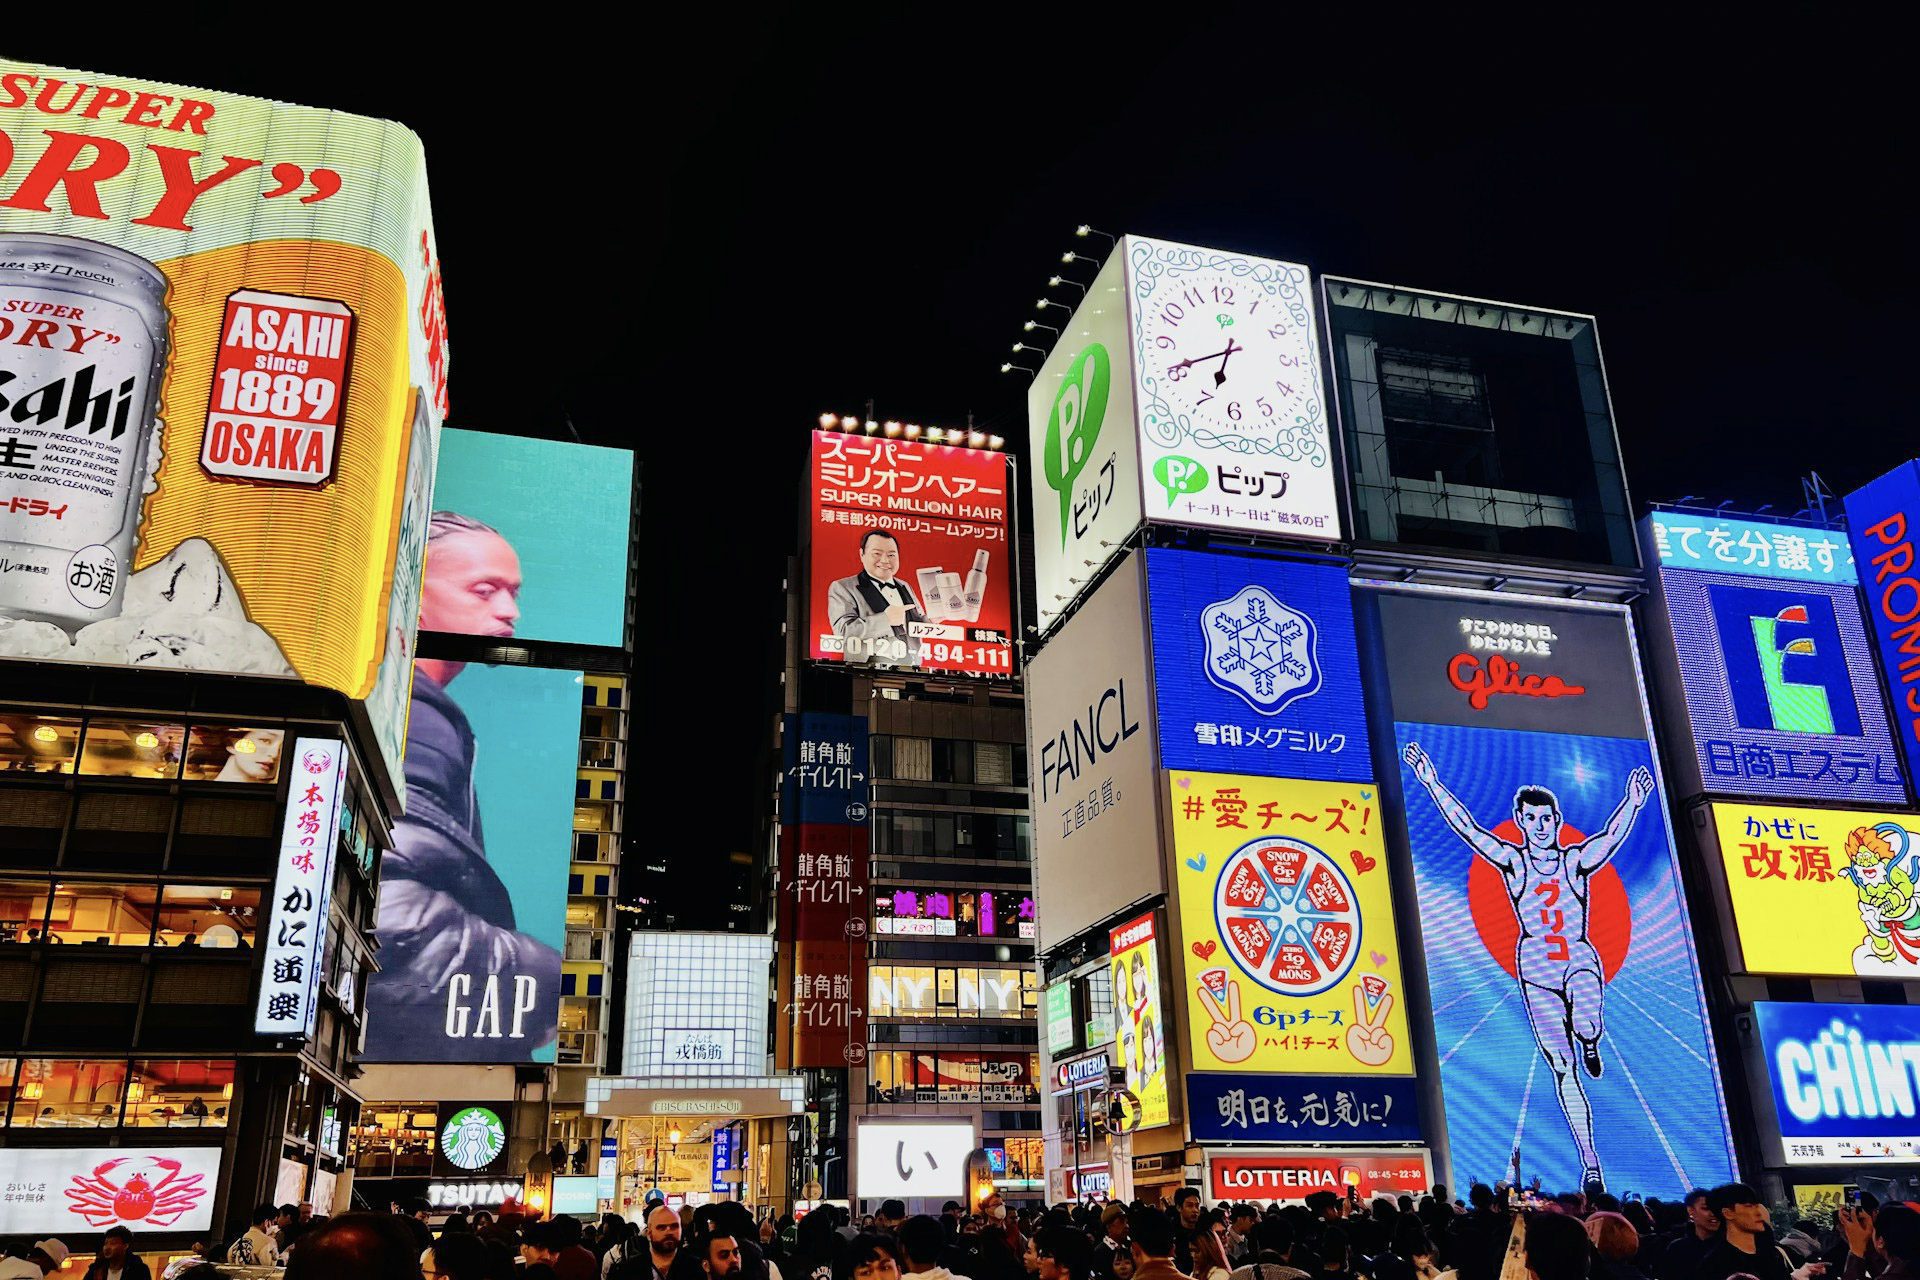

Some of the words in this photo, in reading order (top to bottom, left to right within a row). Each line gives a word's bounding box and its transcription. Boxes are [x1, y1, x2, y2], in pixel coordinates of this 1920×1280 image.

[1, 73, 216, 135] SUPER
[74, 269, 115, 284] KUCHI
[1183, 287, 1205, 308] 11
[1211, 285, 1235, 306] 12
[1249, 300, 1260, 315] 1
[3, 299, 84, 321] SUPER
[1160, 302, 1185, 327] 10
[225, 306, 345, 360] ASAHI
[1155, 335, 1176, 350] 9
[1268, 323, 1287, 340] 2
[254, 353, 309, 375] since
[1167, 365, 1188, 382] 8
[1279, 354, 1299, 368] 3
[219, 367, 336, 421] 1889
[1196, 389, 1215, 406] 7
[1276, 380, 1295, 397] 4
[1226, 401, 1242, 421] 6
[1256, 396, 1273, 418] 5
[22, 427, 48, 438] WITH
[50, 432, 93, 446] PRECISION
[94, 441, 105, 450] TO
[105, 443, 121, 455] HIGH
[45, 443, 77, 454] UNDER
[79, 449, 95, 459] THE
[209, 420, 324, 474] OSAKA
[820, 437, 922, 467] スーパー
[43, 453, 81, 467] MASTER
[5, 471, 29, 480] AND
[62, 479, 90, 492] CLEAN
[40, 465, 59, 474] ING
[62, 468, 116, 487] TECHNIQUES
[820, 460, 1002, 499] ミリオンヘアー
[1217, 464, 1290, 499] ピップ
[820, 488, 883, 508] SUPER
[887, 496, 954, 517] MILLION
[958, 504, 1003, 521] HAIR
[1073, 451, 1117, 540] ピップ
[70, 560, 116, 597] お酒
[912, 624, 946, 637] ルアン
[1470, 635, 1552, 656] ゆたかな人生
[1447, 652, 1586, 710] Glico
[1041, 677, 1140, 804] FANCL
[1193, 722, 1346, 755] 雪印メグミルク
[800, 740, 854, 765] 龍角散
[1704, 739, 1904, 785] 日商エステム
[1061, 776, 1122, 839] 正直品質。
[291, 782, 324, 875] 本場の味
[1743, 815, 1819, 841] かぜに
[798, 853, 854, 878] 龍角散
[1266, 850, 1300, 863] SNOW
[1738, 842, 1836, 883] 改源
[1229, 865, 1250, 900] SNOW
[1319, 871, 1347, 905] SNOW
[1534, 878, 1570, 961] グリコ
[267, 885, 313, 1021] かに道楽
[1231, 925, 1257, 960] SNOW
[1328, 929, 1348, 965] SNOW
[793, 974, 852, 999] 龍角散
[1278, 969, 1312, 980] SNOW
[872, 975, 931, 1010] NY
[958, 977, 1016, 1011] NY
[444, 973, 537, 1039] GAP
[685, 1034, 713, 1044] なんば
[675, 1044, 722, 1060] 戎橋筋
[1068, 1054, 1107, 1081] LOTTERIA
[896, 1140, 939, 1182] い
[1791, 1145, 1825, 1157] 天気予報
[6, 1182, 48, 1192] おいしさ
[1223, 1169, 1338, 1188] LOTTERIA
[4, 1192, 46, 1204] 年中無休
[428, 1182, 524, 1207] TSUTAY
